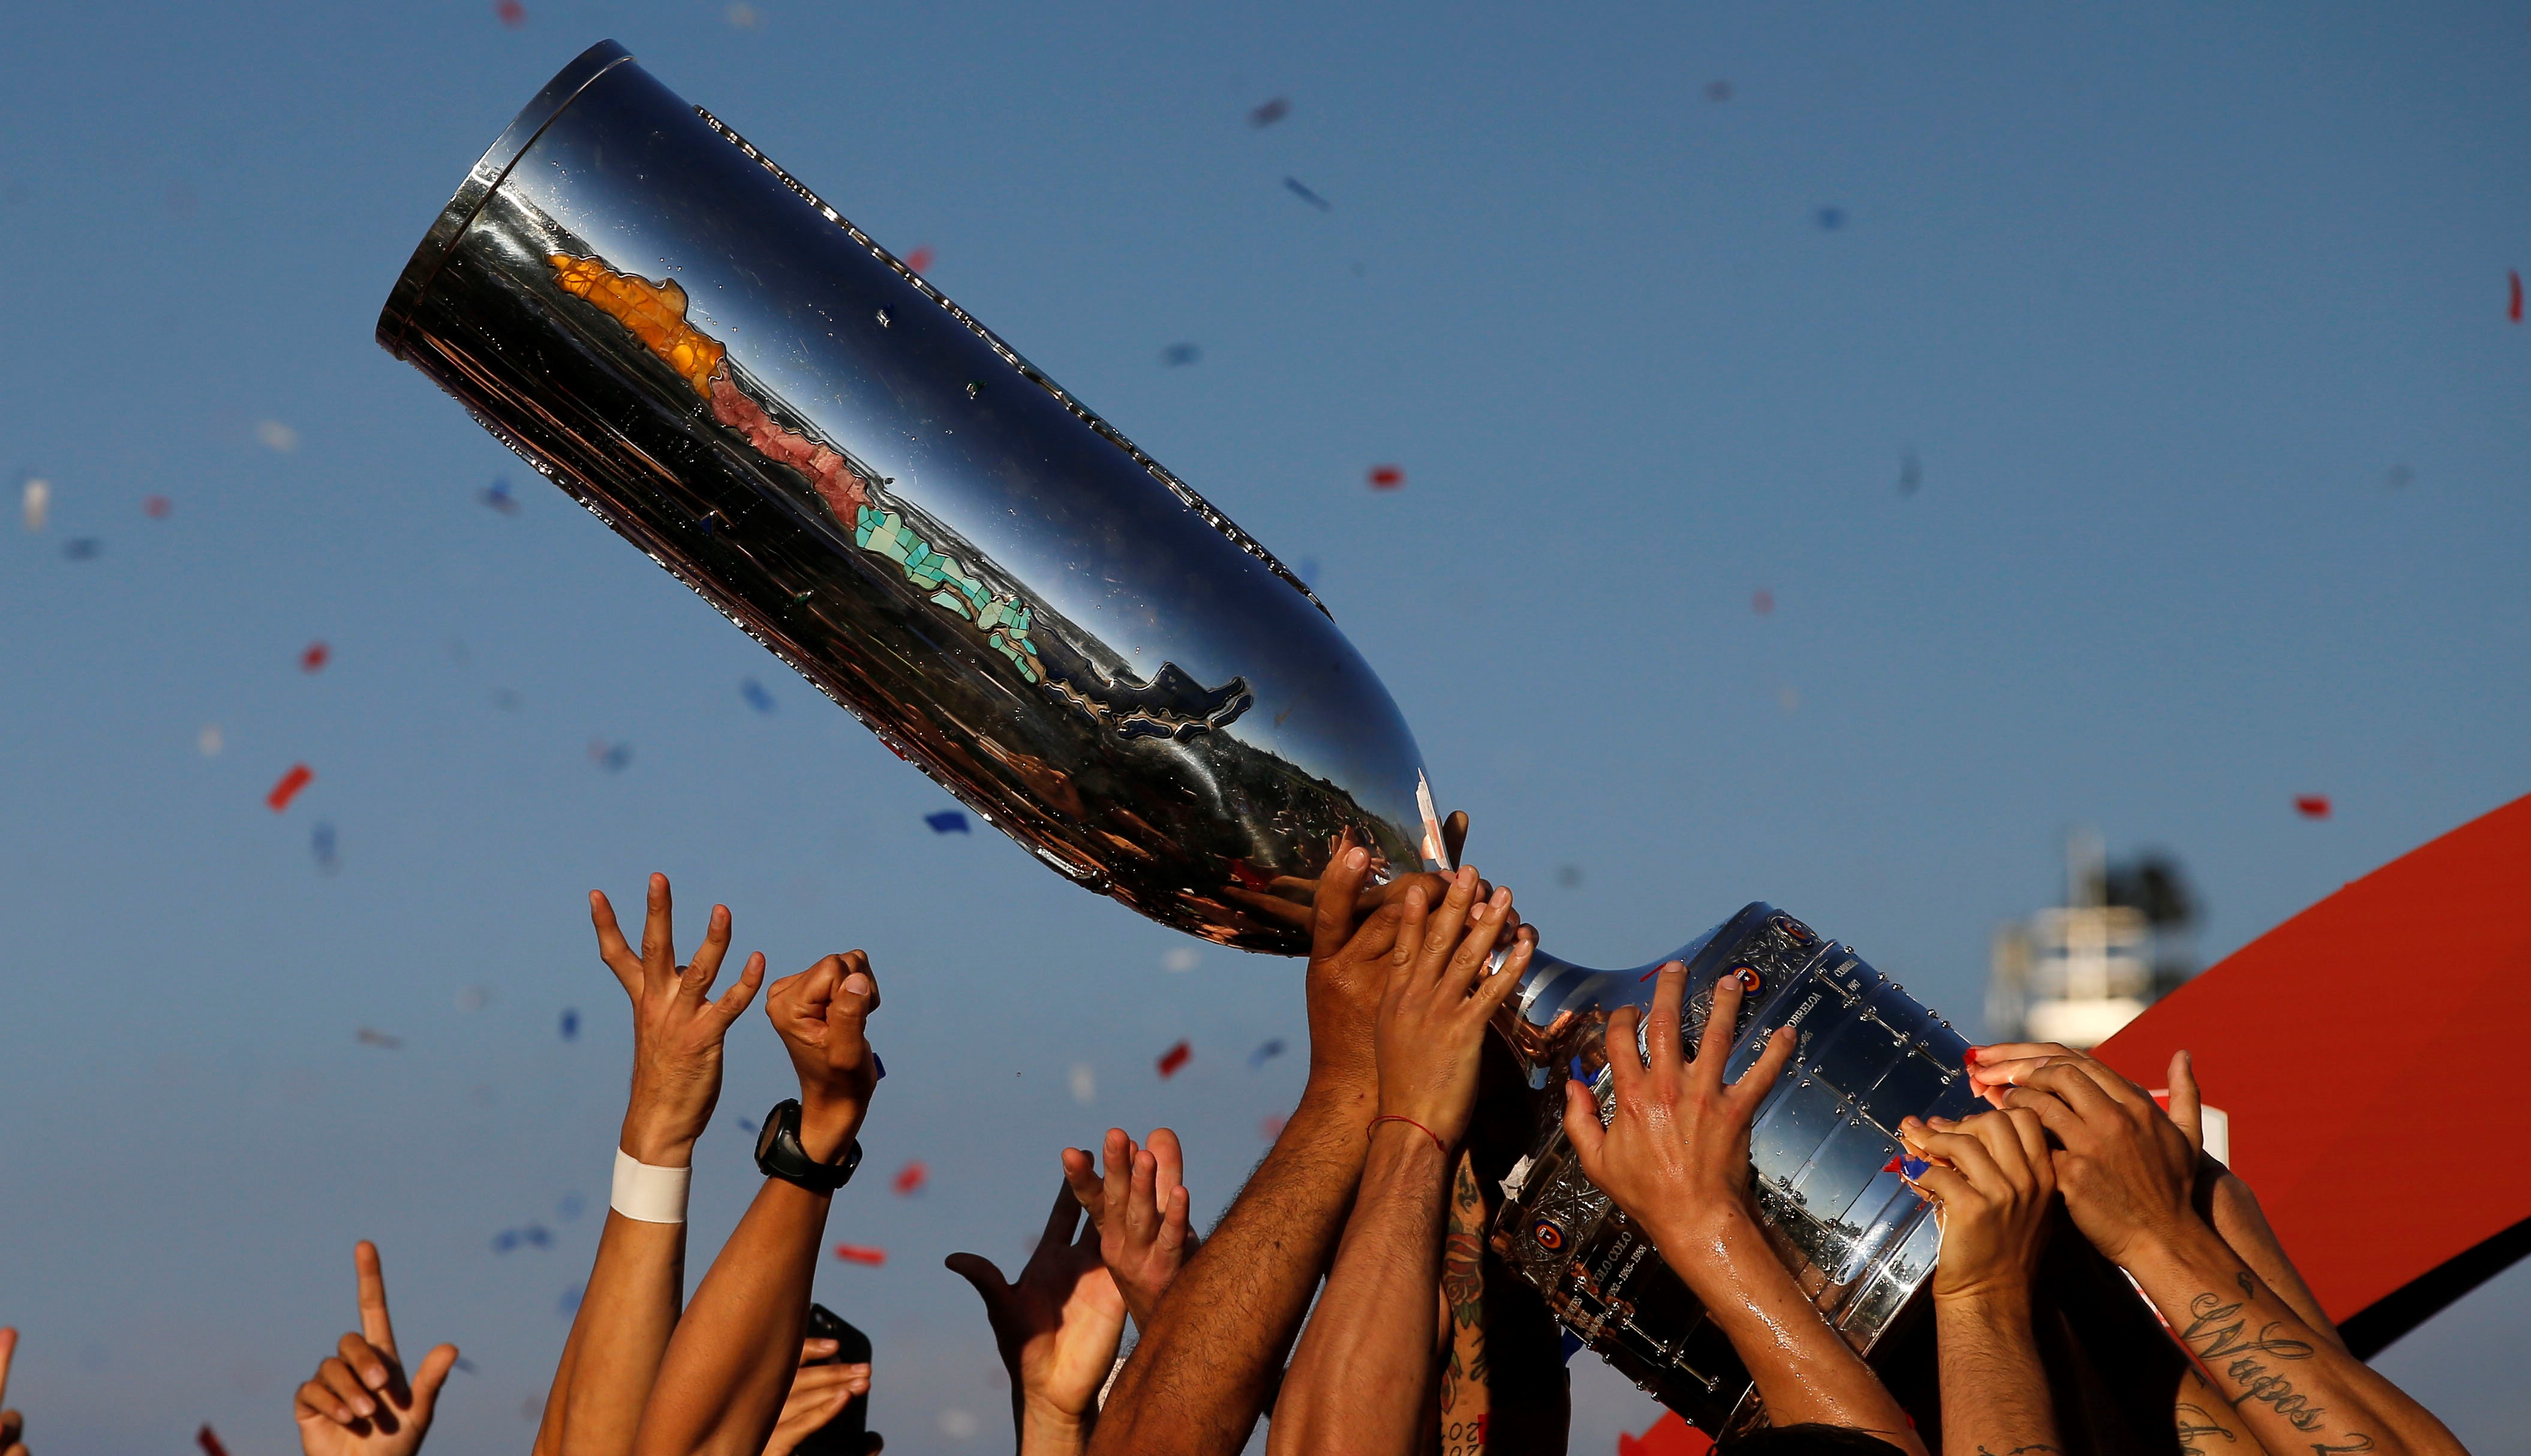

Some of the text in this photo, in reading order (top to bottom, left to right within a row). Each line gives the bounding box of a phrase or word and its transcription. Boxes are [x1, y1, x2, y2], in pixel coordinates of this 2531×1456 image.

[1784, 992, 1823, 1028] OBRELOA
[1592, 1261, 1612, 1287] COLO
[1608, 1231, 1631, 1261] COLO
